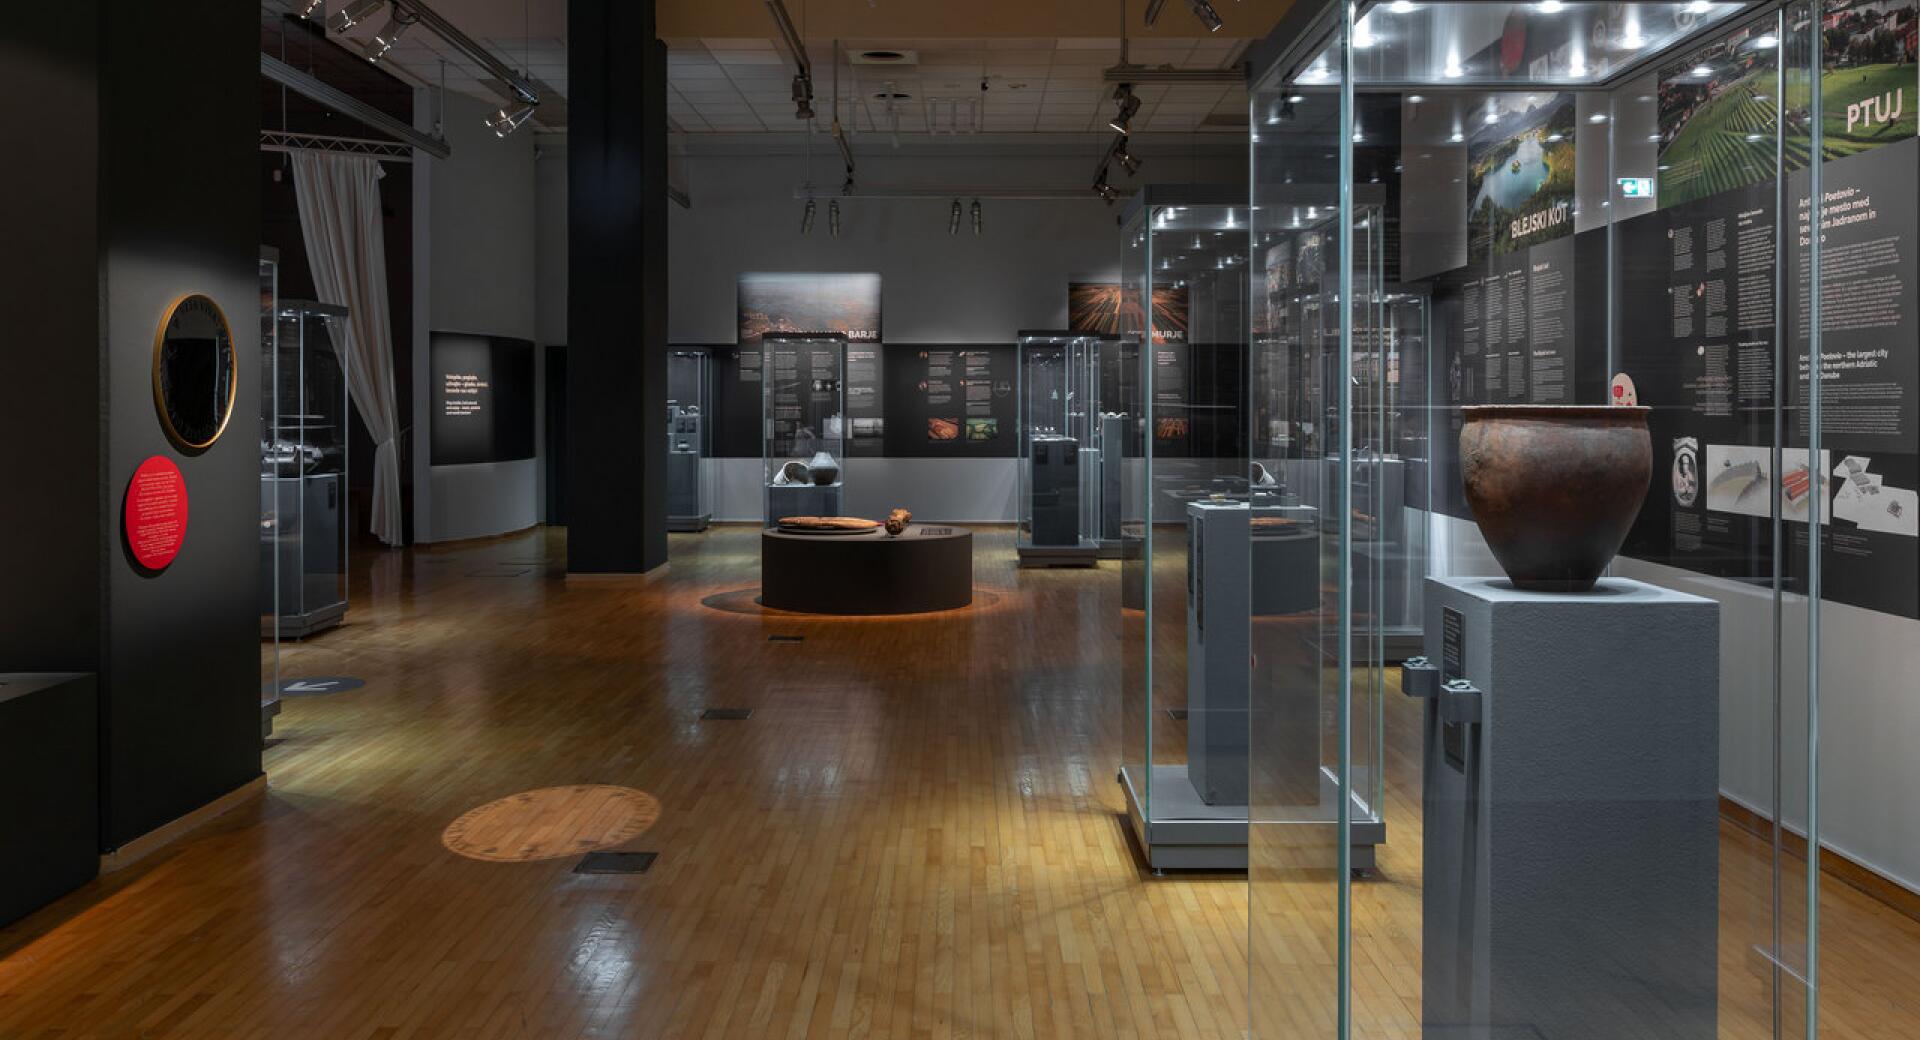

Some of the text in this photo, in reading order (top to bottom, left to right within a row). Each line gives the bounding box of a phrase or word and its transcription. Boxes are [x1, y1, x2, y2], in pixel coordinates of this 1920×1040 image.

[1847, 88, 1903, 133] PTUJ
[1825, 187, 1854, 203] Poetovio
[1829, 201, 1852, 214] mesto
[1852, 197, 1870, 208] med
[1511, 204, 1568, 239] BLEJSKI KOT
[1832, 211, 1868, 227] Jadranom
[1869, 208, 1877, 219] in
[848, 330, 877, 339] BARJE
